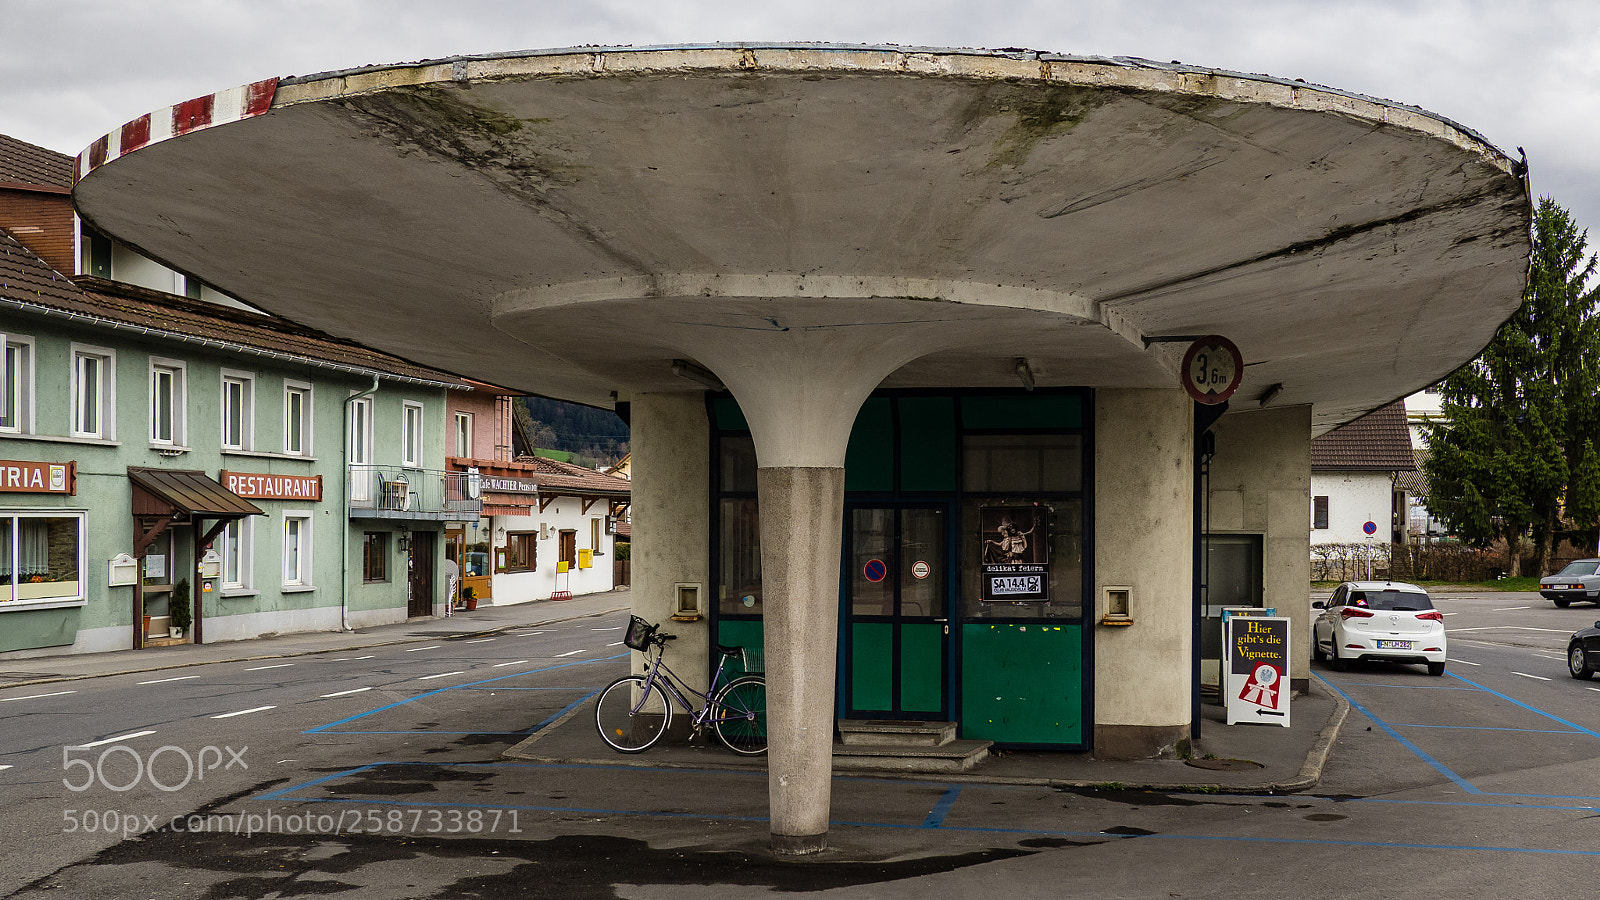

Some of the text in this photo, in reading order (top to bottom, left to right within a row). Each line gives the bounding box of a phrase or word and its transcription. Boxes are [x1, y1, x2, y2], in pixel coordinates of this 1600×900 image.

[228, 475, 317, 497] RESTAURANT
[994, 577, 1027, 589] SA 14.4.
[1247, 621, 1272, 634] Hier
[1237, 634, 1282, 646] gibt's die
[1237, 646, 1282, 661] Vignette.
